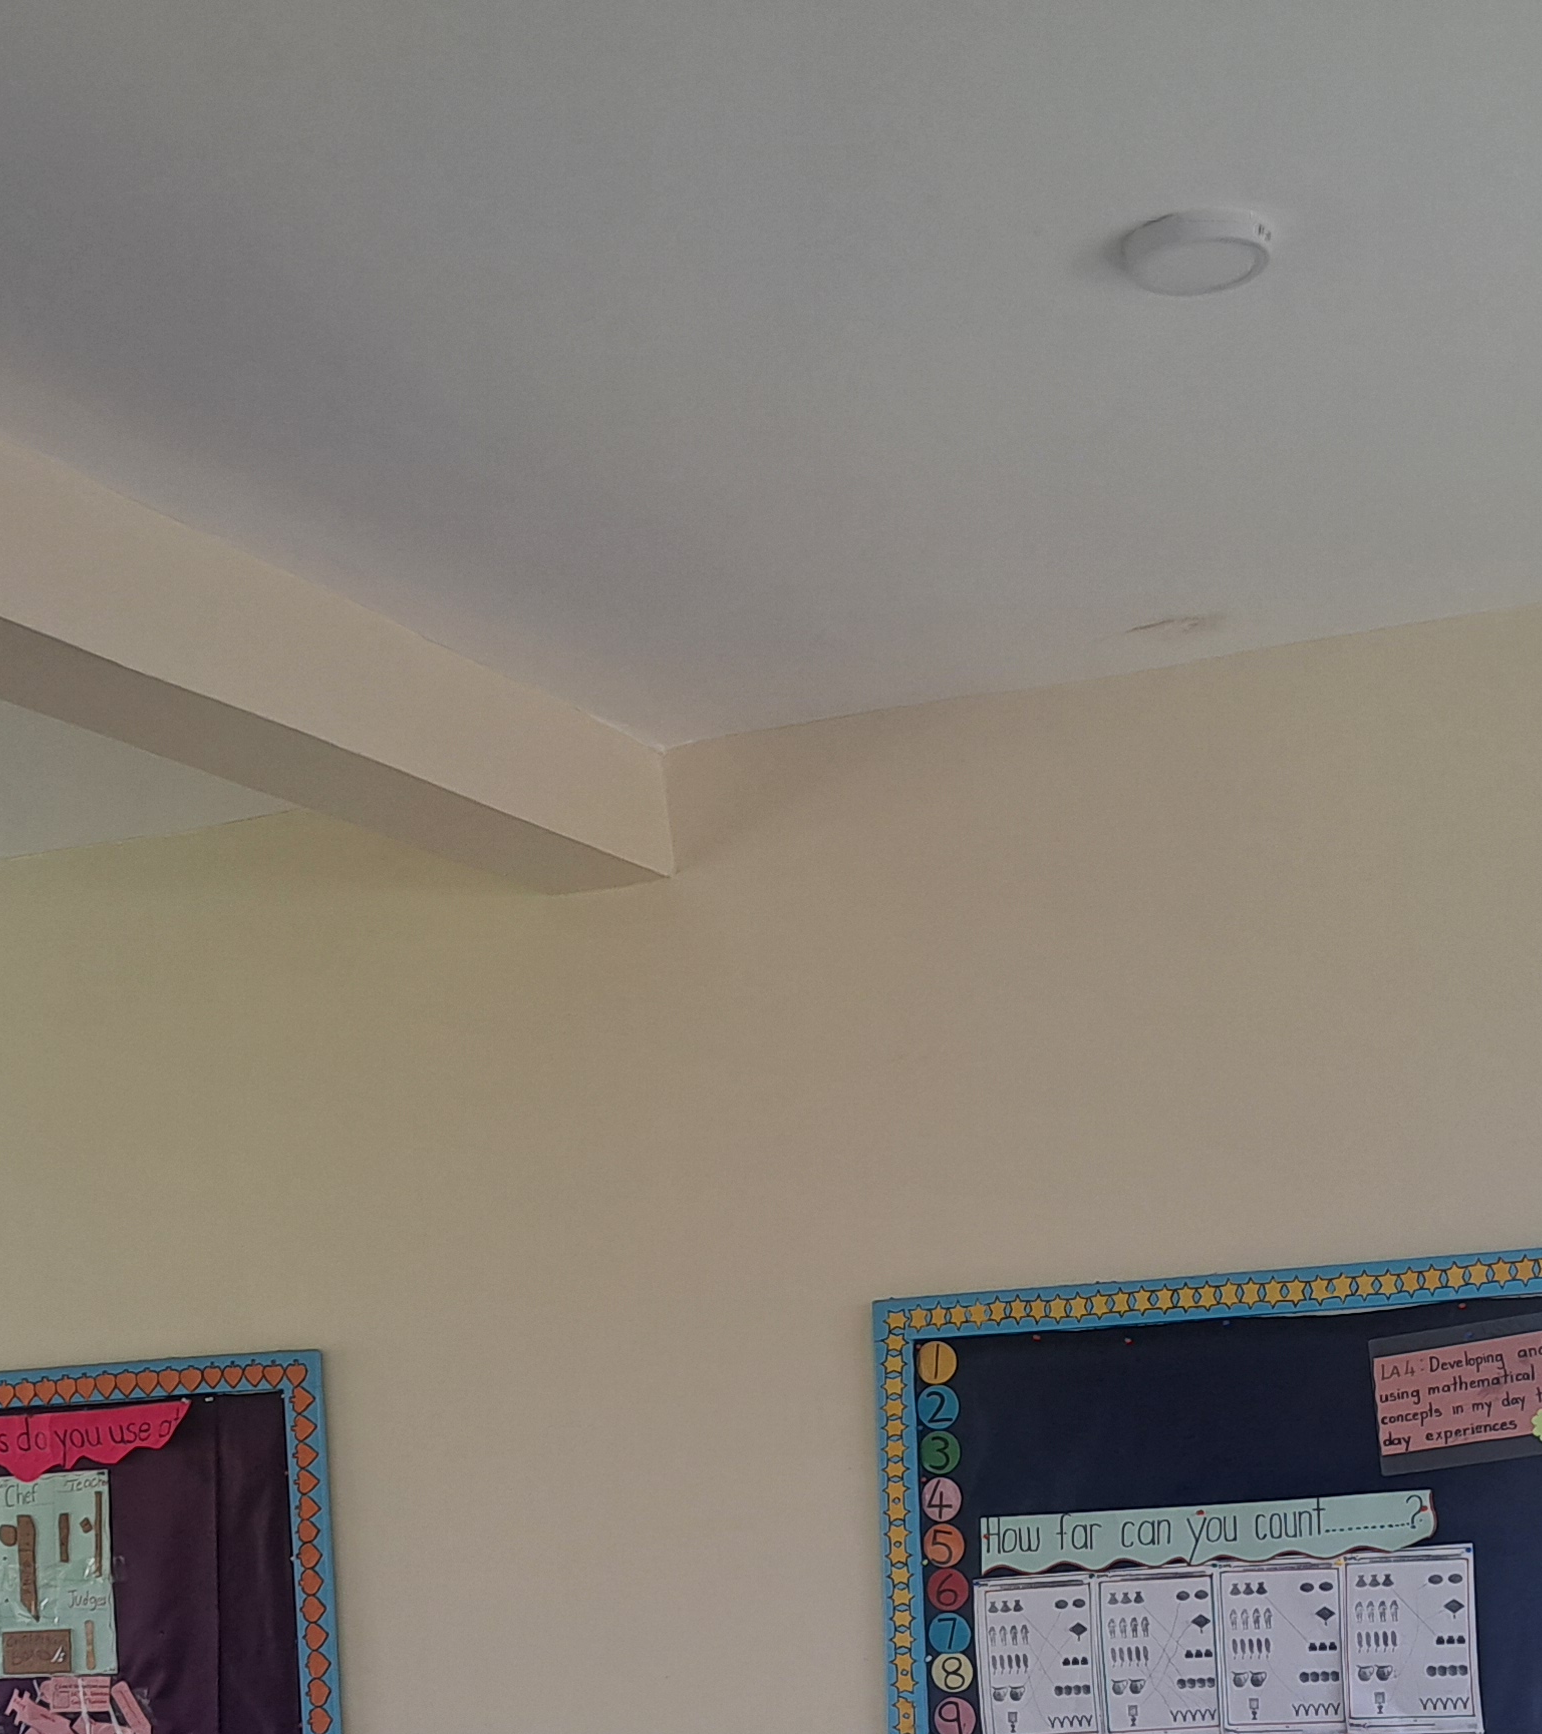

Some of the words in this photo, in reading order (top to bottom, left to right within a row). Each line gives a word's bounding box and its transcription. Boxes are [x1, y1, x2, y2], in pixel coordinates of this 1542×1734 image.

[934, 1343, 940, 1380] 1
[1429, 1350, 1505, 1374] Developing
[1379, 1388, 1421, 1406] using
[1427, 1364, 1535, 1396] mathematical
[925, 1390, 954, 1424] 2
[1381, 1402, 1443, 1427] concepts
[1452, 1403, 1464, 1415] in
[1472, 1400, 1493, 1417] my
[1501, 1391, 1526, 1411] day
[17, 1415, 48, 1450] do
[54, 1426, 101, 1470] you
[109, 1420, 151, 1445] use
[928, 1435, 950, 1471] 3
[1382, 1430, 1412, 1451] day
[1425, 1419, 1517, 1444] experiences
[4, 1483, 39, 1508] Chef
[926, 1479, 953, 1520] 4
[931, 1529, 954, 1566] 5
[986, 1516, 1041, 1555] How
[1056, 1512, 1103, 1551] far
[1121, 1518, 1172, 1550] can
[1186, 1514, 1238, 1566] you
[935, 1573, 959, 1607] 6
[937, 1617, 959, 1650] 7
[941, 1656, 965, 1690] 8
